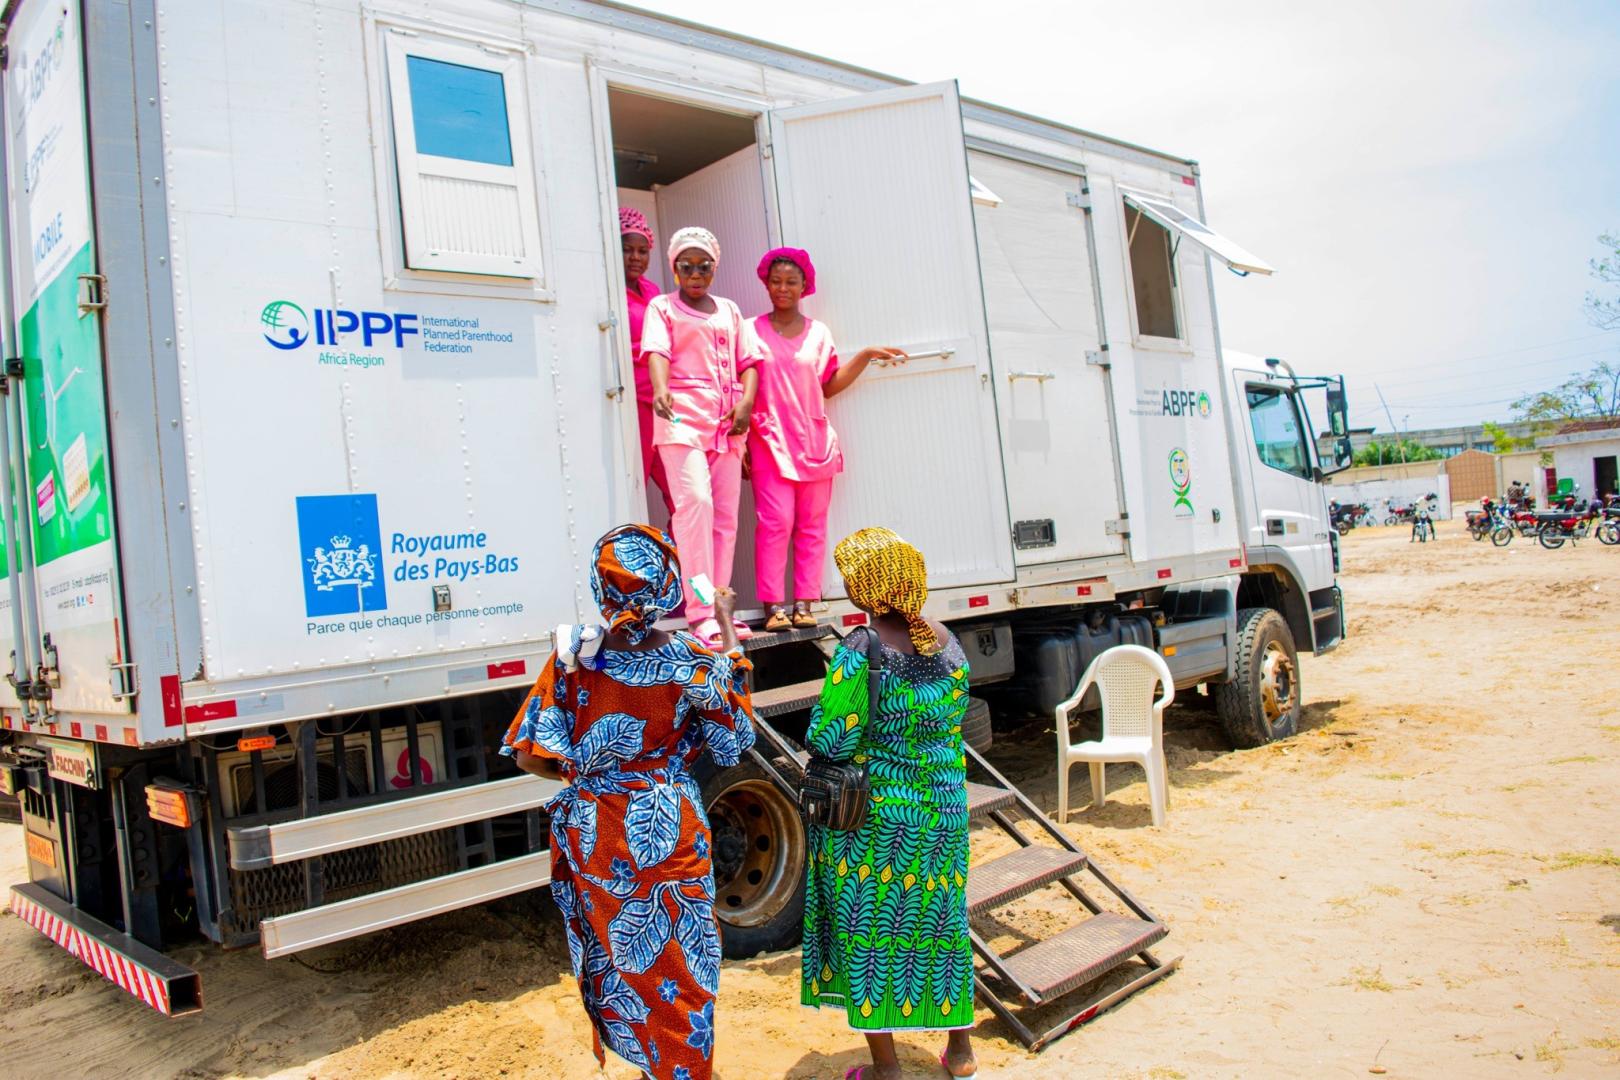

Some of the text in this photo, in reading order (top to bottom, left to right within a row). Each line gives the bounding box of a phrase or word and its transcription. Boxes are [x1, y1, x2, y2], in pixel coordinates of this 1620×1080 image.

[34, 212, 63, 264] MOBILE
[314, 308, 418, 348] IPPF
[422, 315, 480, 329] International
[423, 328, 513, 343] Planned Parenthood
[318, 352, 385, 369] Africa Region
[424, 341, 473, 354] Federation
[1162, 389, 1196, 417] ABPF
[391, 532, 487, 559] Royaume
[393, 554, 519, 582] des Pays-Bas
[306, 600, 524, 636] Parce que chaque personne compte
